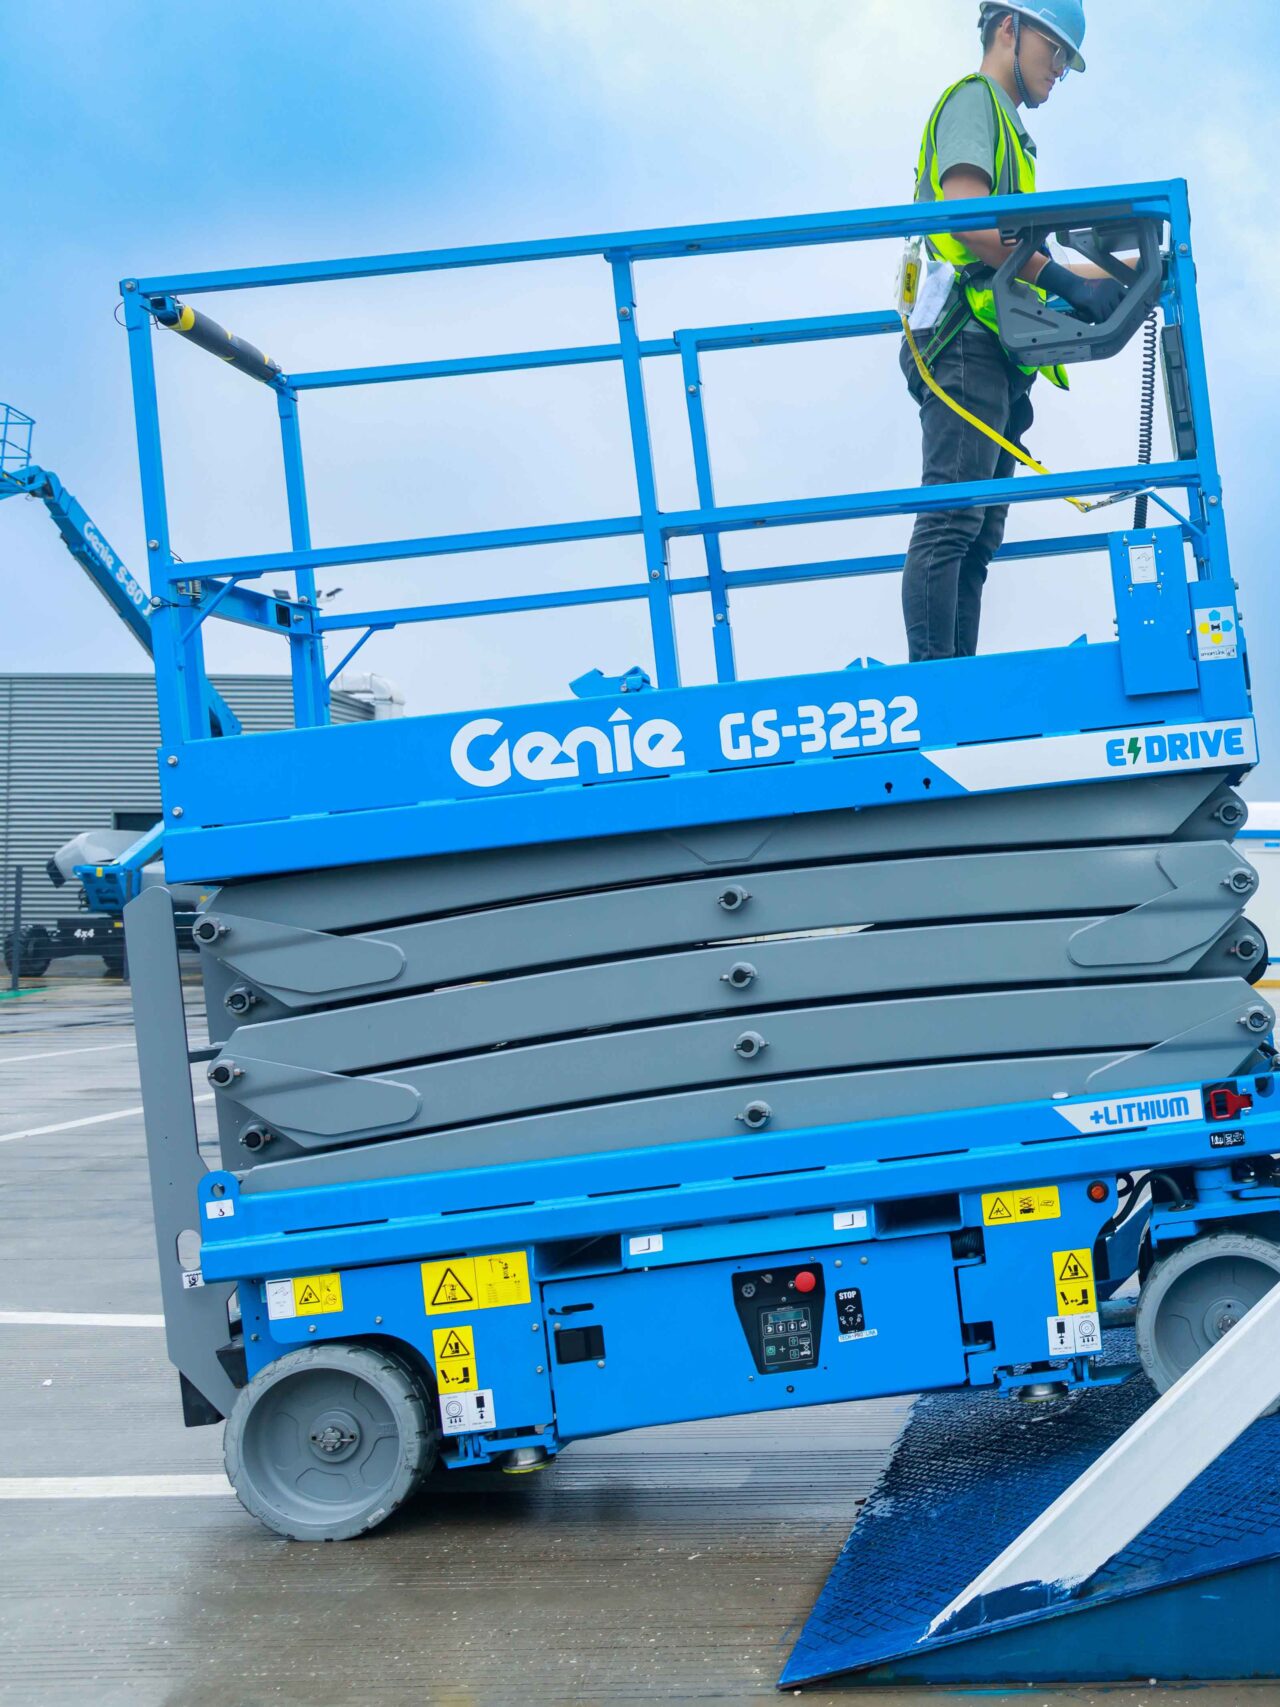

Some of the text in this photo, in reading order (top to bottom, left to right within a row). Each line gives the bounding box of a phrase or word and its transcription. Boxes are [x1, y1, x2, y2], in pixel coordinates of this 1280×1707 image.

[84, 521, 114, 570] Genie
[116, 565, 143, 605] S-80
[450, 696, 922, 787] Genie GS-3232
[74, 928, 95, 938] 4x4
[838, 1290, 857, 1300] STOP
